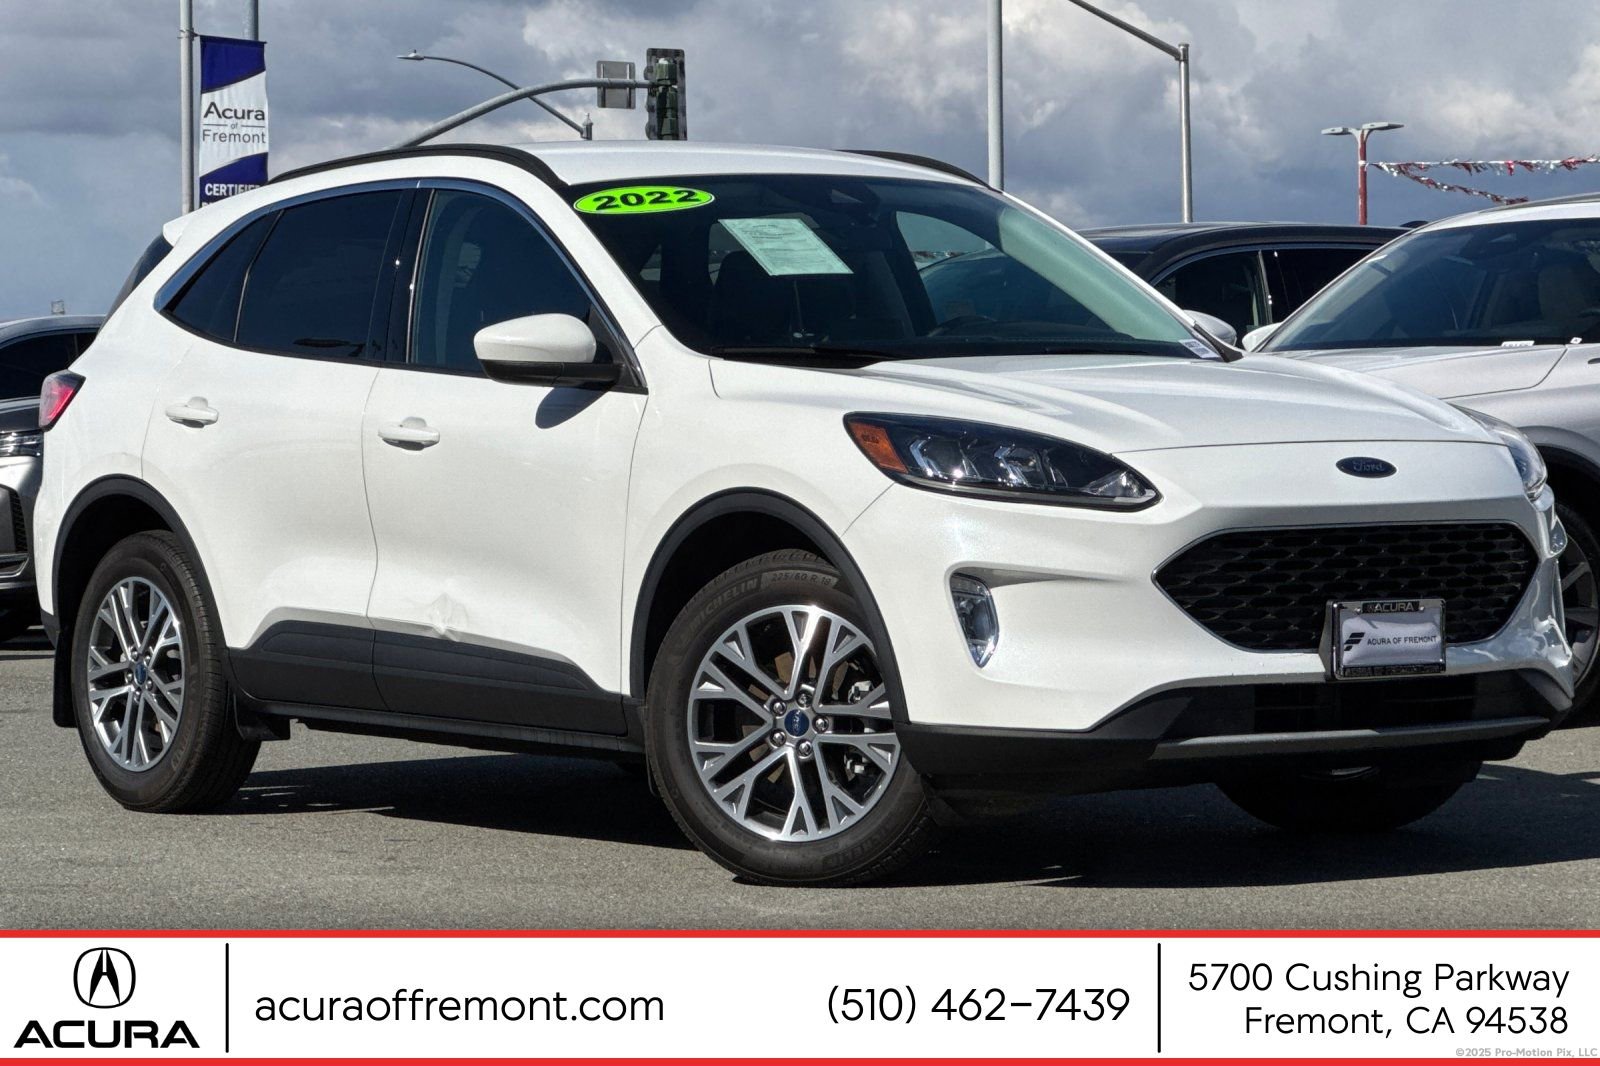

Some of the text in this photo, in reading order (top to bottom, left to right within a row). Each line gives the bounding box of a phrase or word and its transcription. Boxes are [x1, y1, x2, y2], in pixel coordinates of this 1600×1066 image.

[203, 101, 266, 121] Acura
[202, 129, 266, 144] Fremont
[204, 183, 261, 196] CERTIFI
[593, 190, 701, 211] 2022
[688, 578, 758, 632] MICHELIN
[1374, 601, 1415, 612] ACURA
[1367, 638, 1391, 646] ACURA
[1404, 635, 1437, 643] FREMONT
